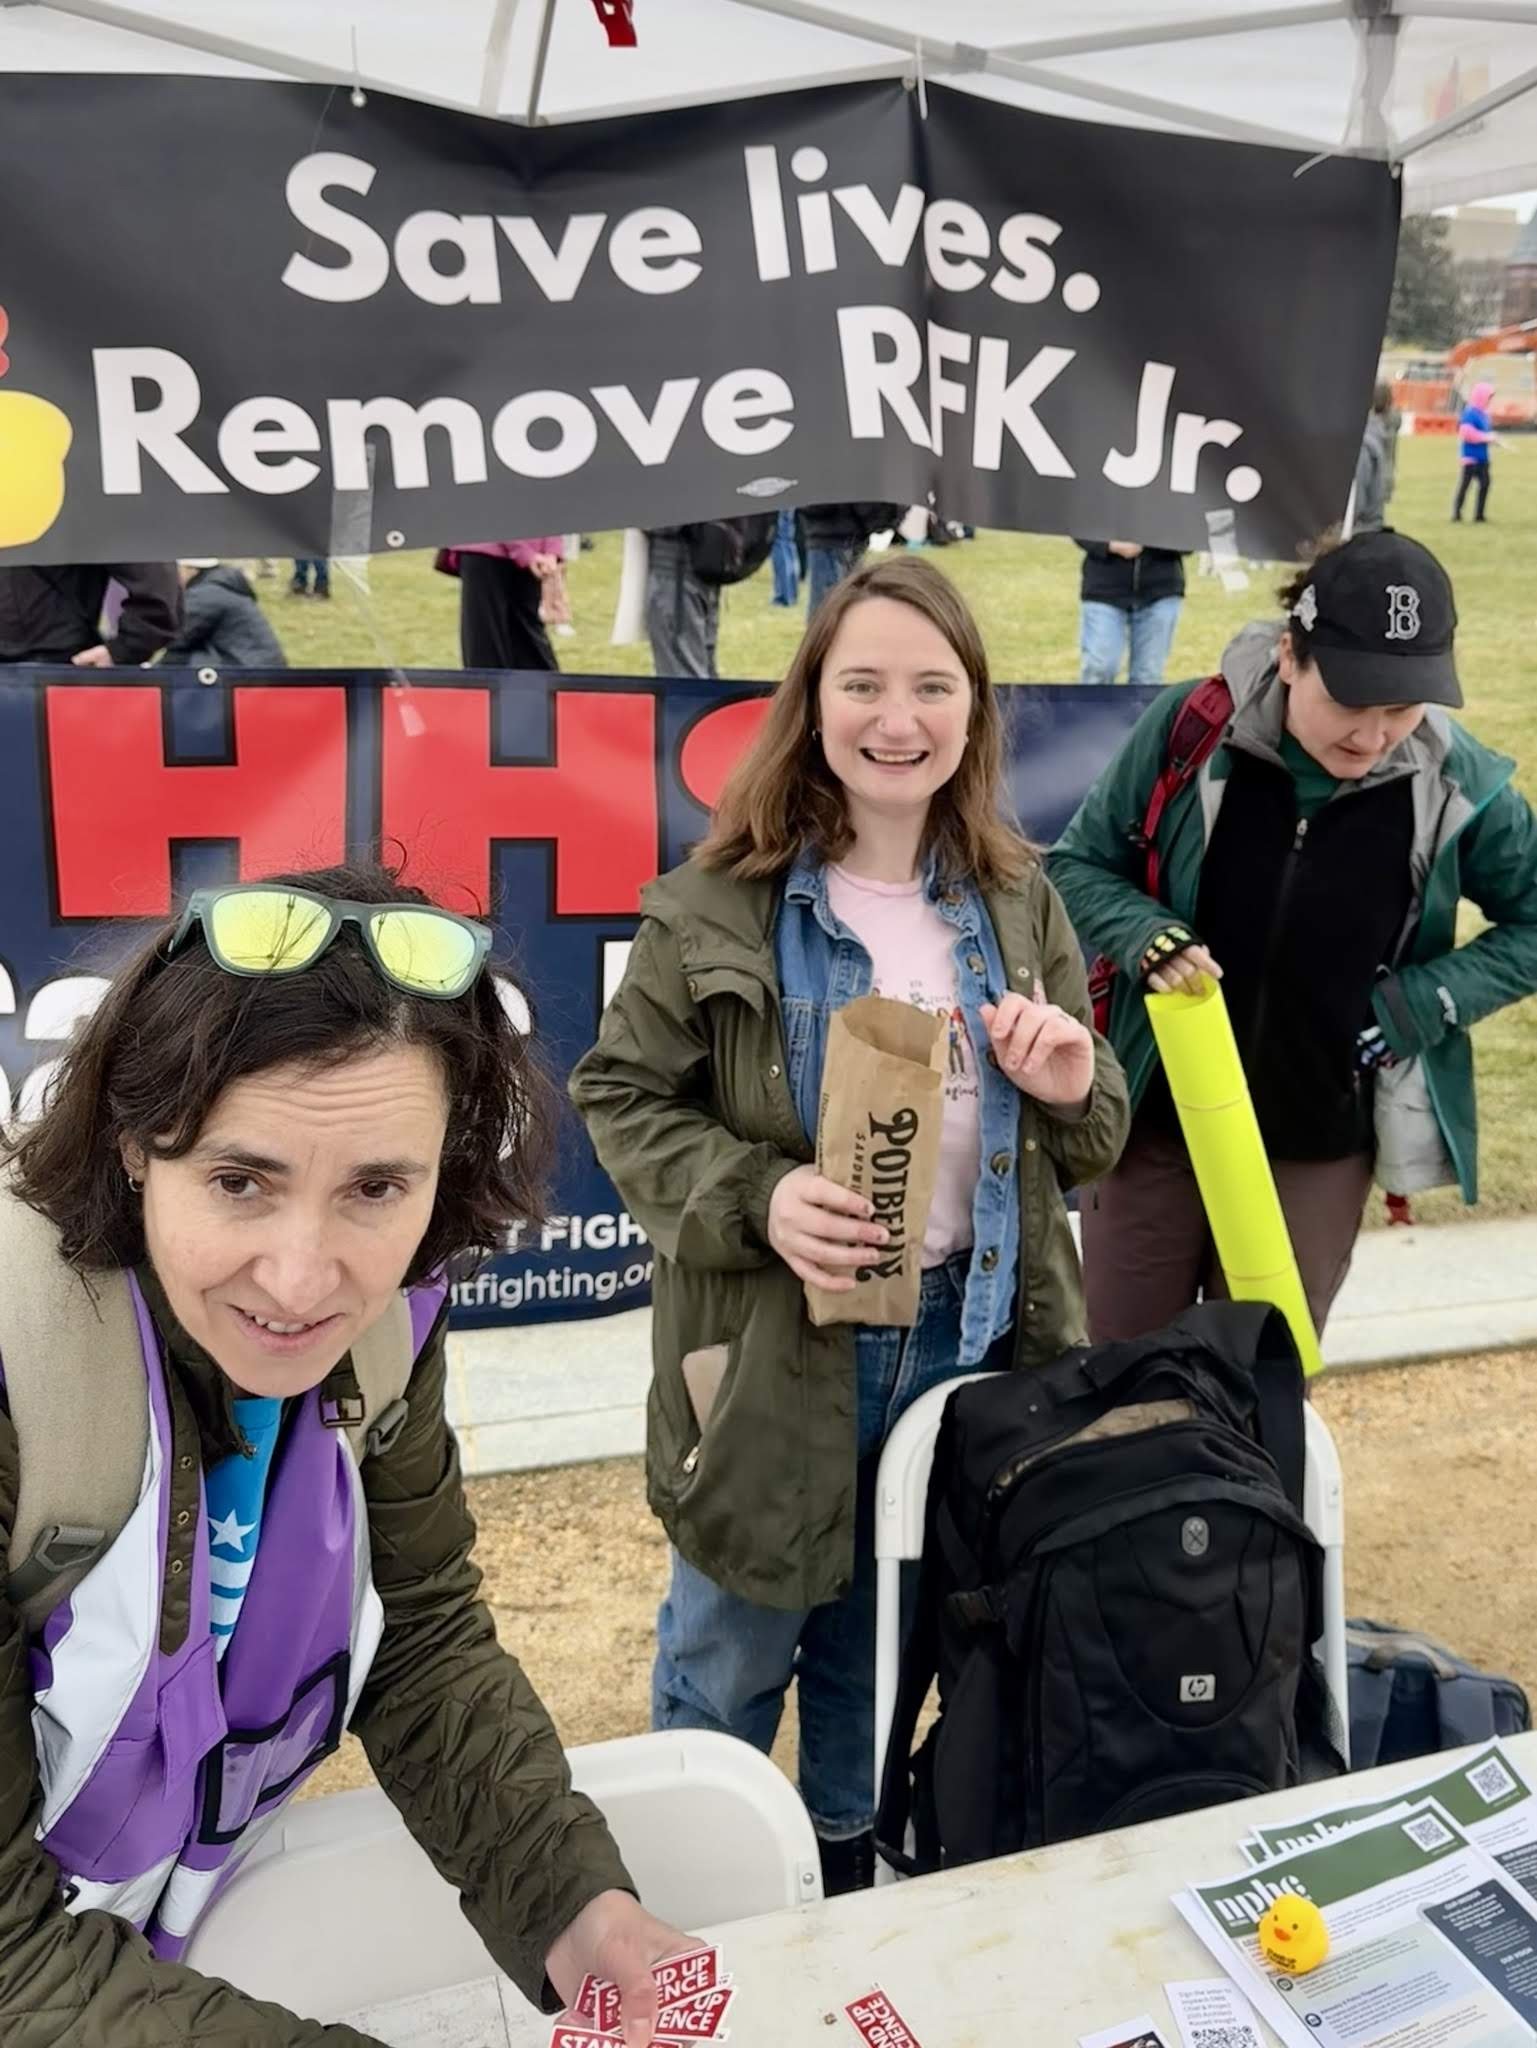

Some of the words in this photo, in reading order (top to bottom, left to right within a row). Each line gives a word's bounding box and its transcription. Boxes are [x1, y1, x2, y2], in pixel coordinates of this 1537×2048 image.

[281, 151, 703, 305] Save
[743, 145, 1101, 312] lives.
[92, 346, 796, 495] Remove
[837, 305, 1077, 479] RFK
[1102, 361, 1262, 502] Jr.
[1385, 585, 1421, 640] B
[540, 1213, 651, 1251] FIGH
[681, 1955, 711, 1974] UP
[657, 1971, 709, 2003] ENCE
[694, 1992, 724, 2010] UP
[658, 2011, 716, 2031] ENCE
[852, 2005, 876, 2028] UP
